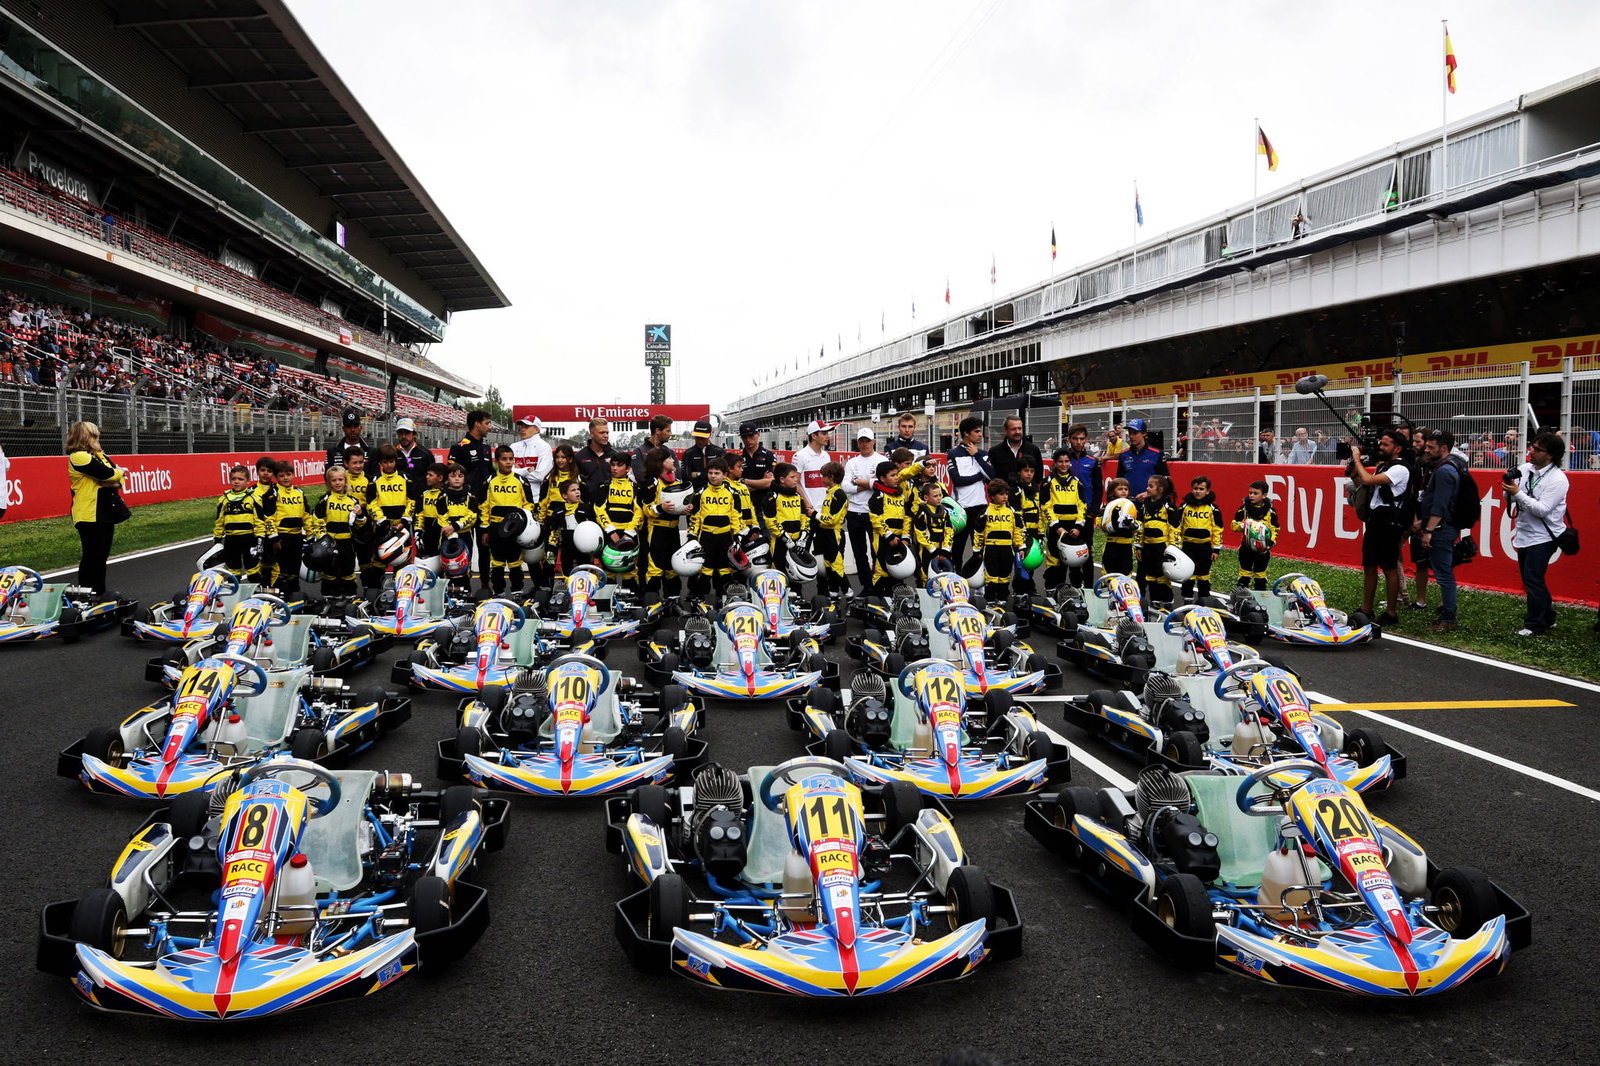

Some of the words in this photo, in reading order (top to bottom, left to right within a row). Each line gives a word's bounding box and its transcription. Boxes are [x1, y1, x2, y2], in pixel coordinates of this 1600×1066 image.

[1427, 352, 1498, 375] DHL
[575, 407, 594, 419] Fly
[597, 406, 650, 418] Emirates
[294, 459, 304, 481] Fly
[303, 457, 326, 477] Emirates
[122, 464, 172, 494] Emirates
[380, 484, 404, 493] RACC
[493, 485, 518, 494] RACC
[609, 488, 634, 498] RACC
[1055, 483, 1077, 493] RACC
[281, 495, 303, 505] RACC
[328, 502, 352, 511] RACC
[705, 496, 730, 506] RACC
[781, 499, 801, 509] RACC
[887, 498, 905, 507] RACC
[1187, 510, 1209, 520] RACC
[1264, 474, 1324, 549] Fly
[986, 514, 1012, 524] RACC
[201, 577, 209, 589] 1
[403, 573, 412, 586] 2
[577, 578, 585, 590] 3
[768, 579, 776, 592] 4
[954, 581, 963, 594] 5
[1124, 583, 1132, 595] 6
[1304, 584, 1320, 596] 16
[239, 608, 261, 625] 17
[487, 613, 498, 628] 7
[735, 617, 755, 634] 21
[961, 617, 981, 633] 18
[1200, 617, 1220, 633] 19
[187, 671, 218, 696] 14
[560, 677, 587, 701] 10
[930, 678, 958, 703] 12
[1275, 679, 1295, 703] 9
[810, 797, 850, 838] 11
[1318, 798, 1368, 840] 20
[242, 804, 268, 847] 8
[819, 853, 850, 864] RACC
[1352, 855, 1381, 865] RACC
[231, 862, 263, 873] RACC
